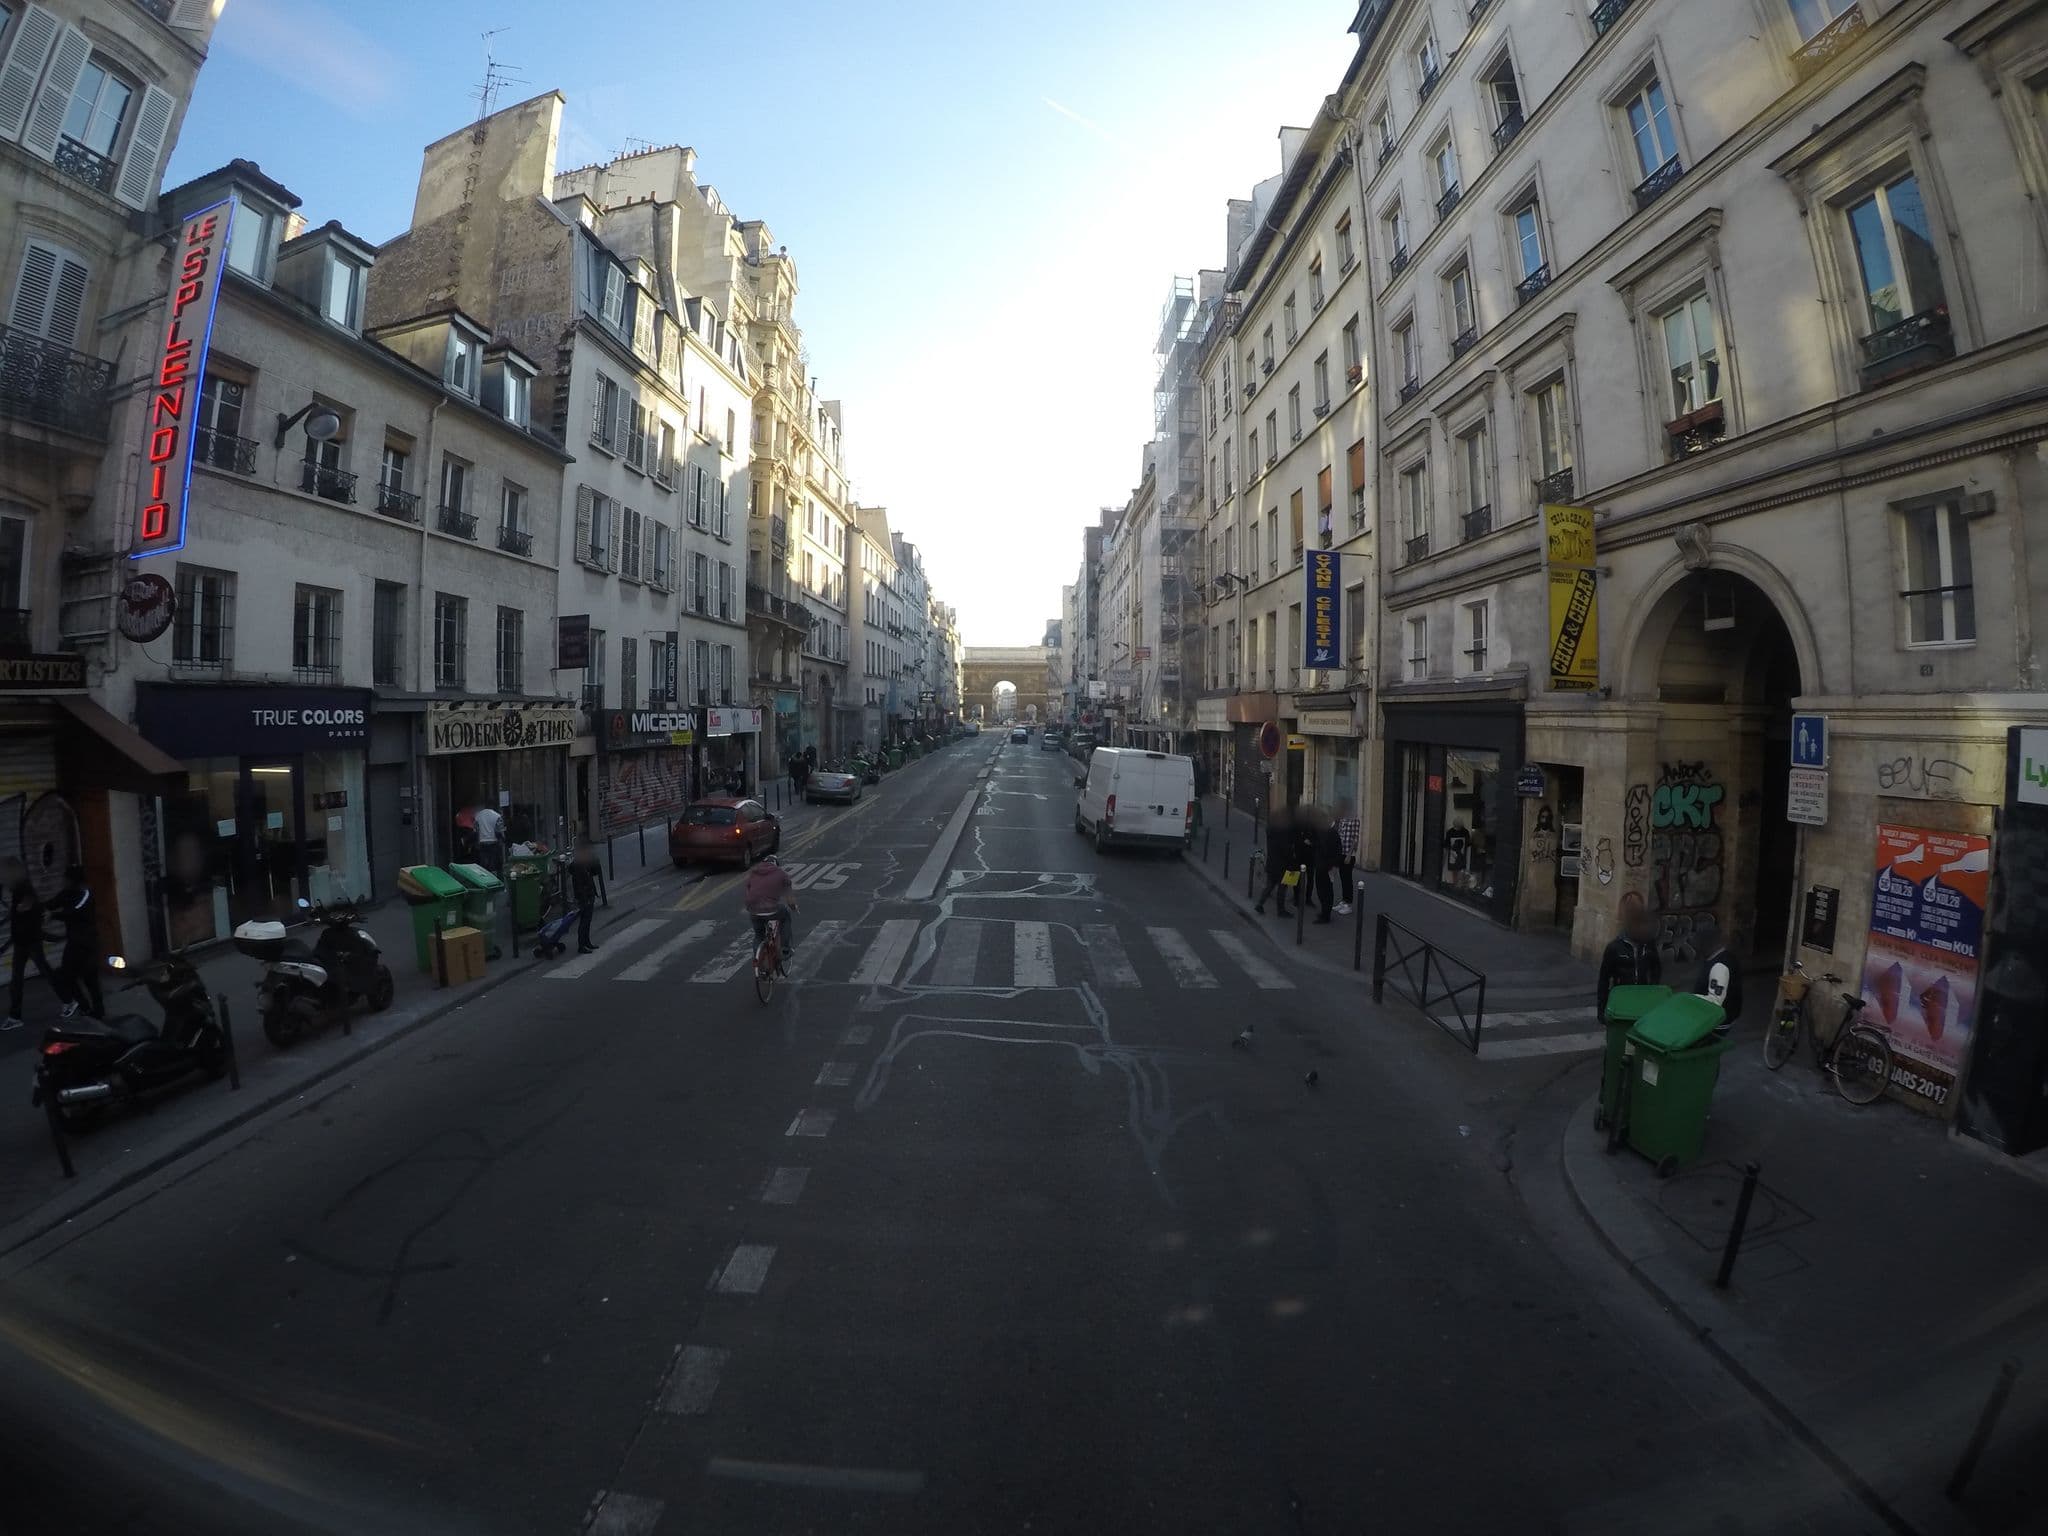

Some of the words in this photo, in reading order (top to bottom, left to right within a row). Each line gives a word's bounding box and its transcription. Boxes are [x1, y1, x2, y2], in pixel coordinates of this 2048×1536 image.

[186, 215, 217, 246] LE
[1568, 570, 1596, 624] CHEAP
[1566, 623, 1580, 636] &
[1551, 634, 1576, 674] CHIC
[252, 710, 299, 727] TRUE
[301, 709, 365, 725] COLORS
[328, 730, 365, 738] PARIS
[433, 721, 503, 749] MODERN
[536, 719, 574, 743] TIMES
[1653, 784, 1726, 829] CKT
[1953, 940, 1975, 958] KOL
[1867, 1056, 1884, 1074] 03
